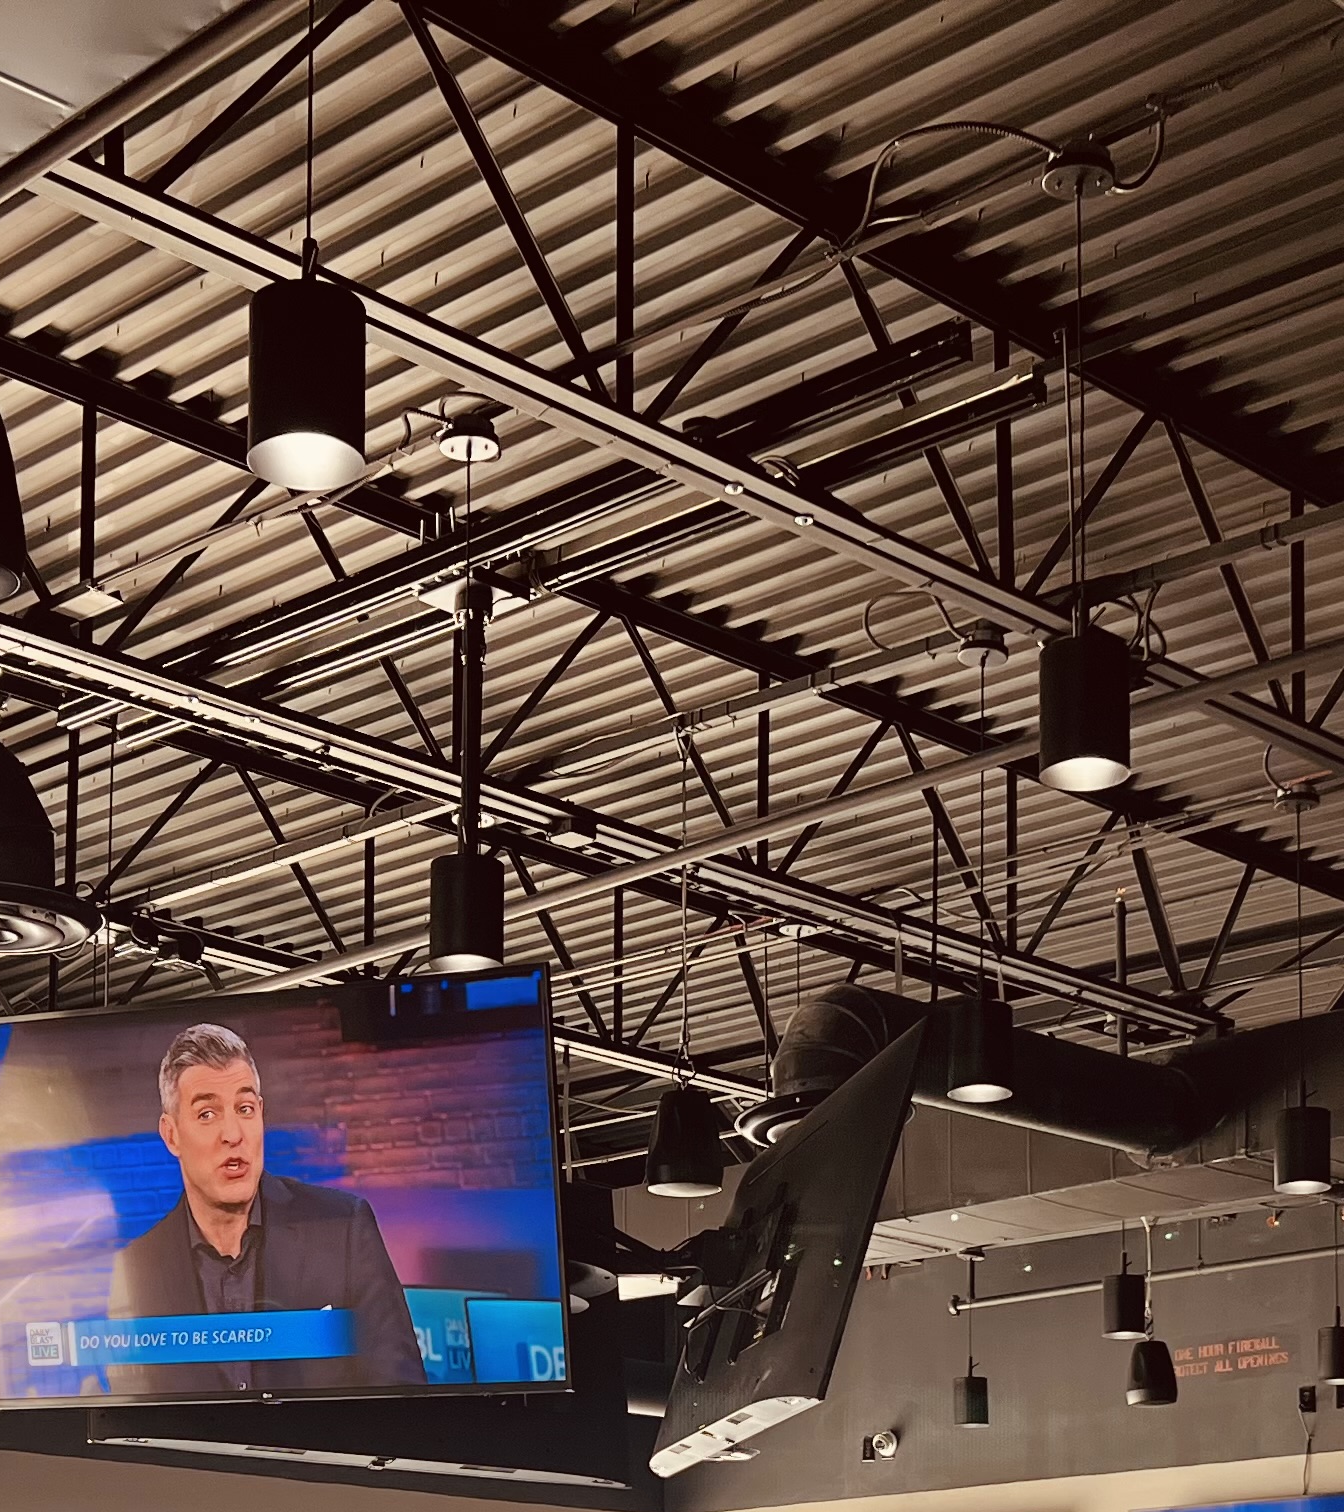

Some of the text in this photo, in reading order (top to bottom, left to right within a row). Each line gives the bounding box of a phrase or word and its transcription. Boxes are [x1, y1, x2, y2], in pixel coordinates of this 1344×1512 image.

[80, 1327, 273, 1350] DO YOU LOVE TO BE SCARED?
[1174, 1336, 1280, 1361] ONE HOUR FIREWALL
[32, 1344, 59, 1359] LIVE
[1214, 1359, 1233, 1373] ALL
[1237, 1351, 1289, 1370] OPENINGS
